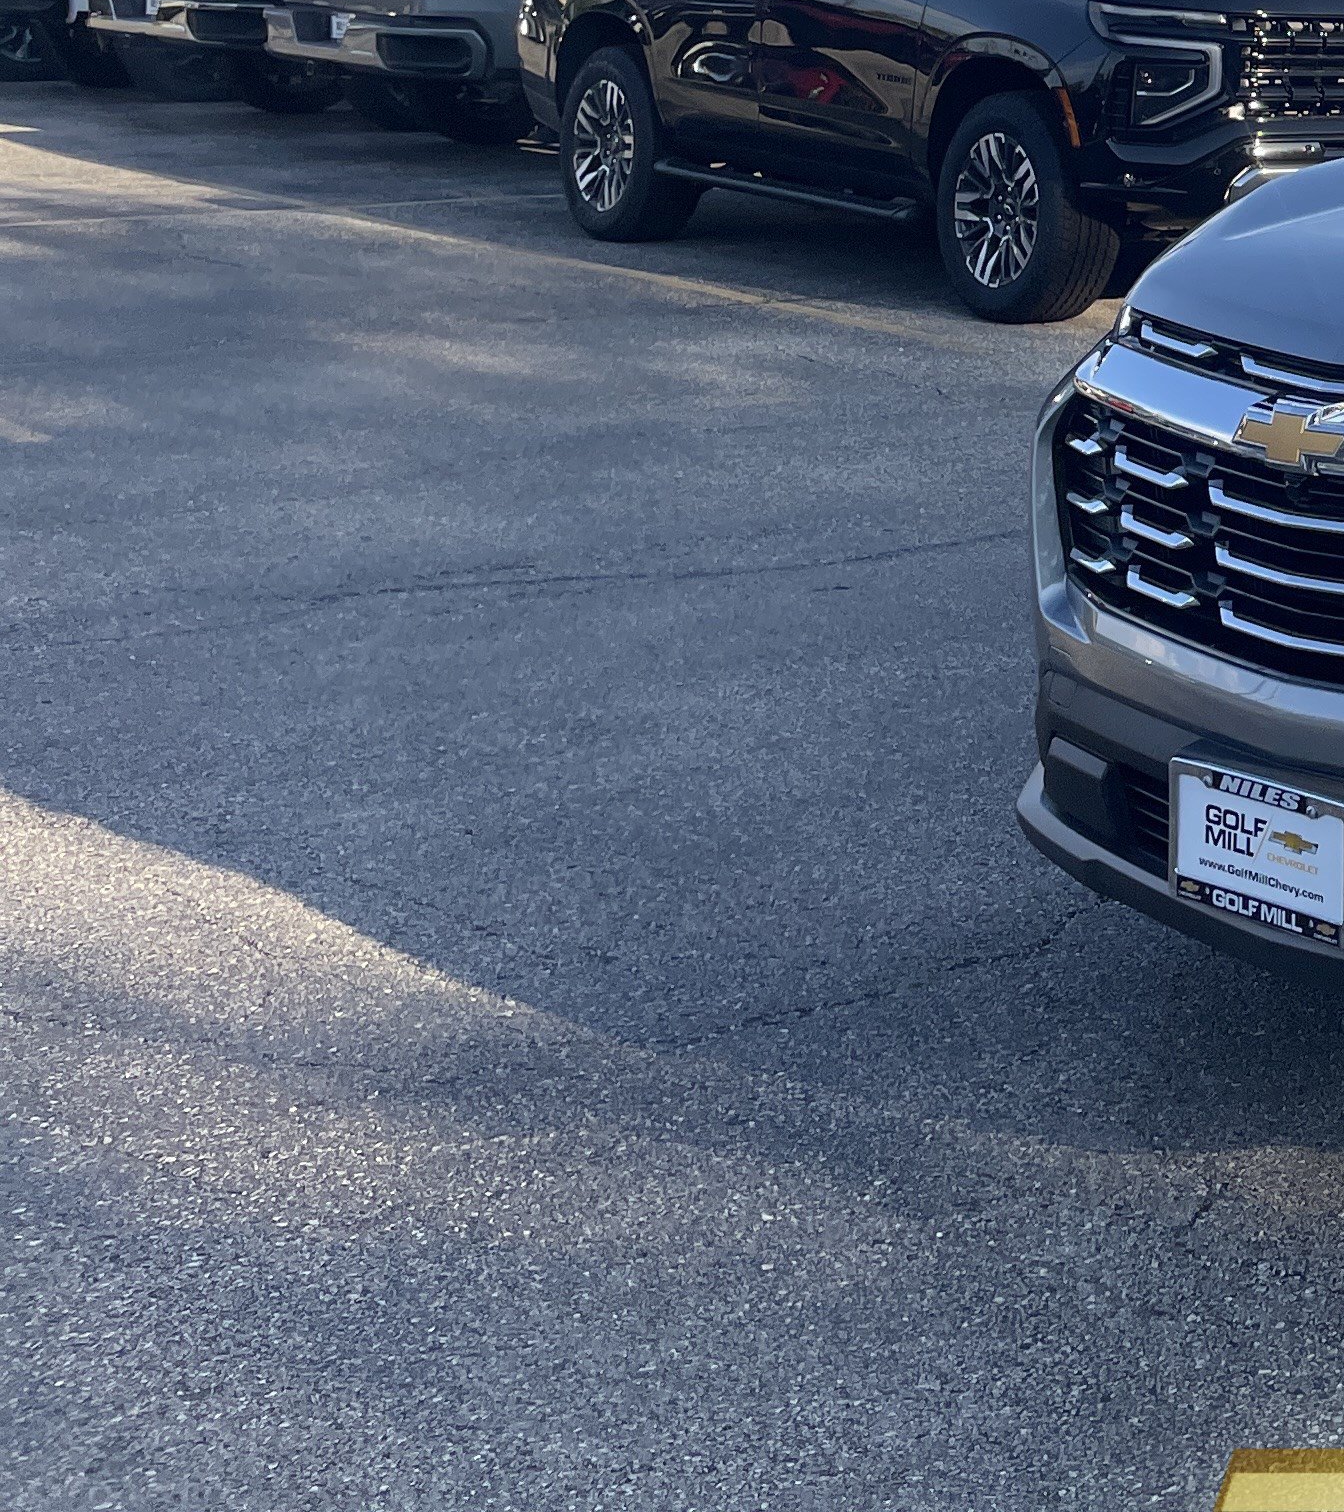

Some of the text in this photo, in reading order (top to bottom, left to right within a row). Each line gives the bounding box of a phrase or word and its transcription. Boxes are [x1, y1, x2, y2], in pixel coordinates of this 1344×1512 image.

[1219, 774, 1301, 811] NILES
[1205, 804, 1267, 838] GOLF
[1205, 824, 1255, 857] MILL
[1212, 888, 1303, 933] GOLF MILL
